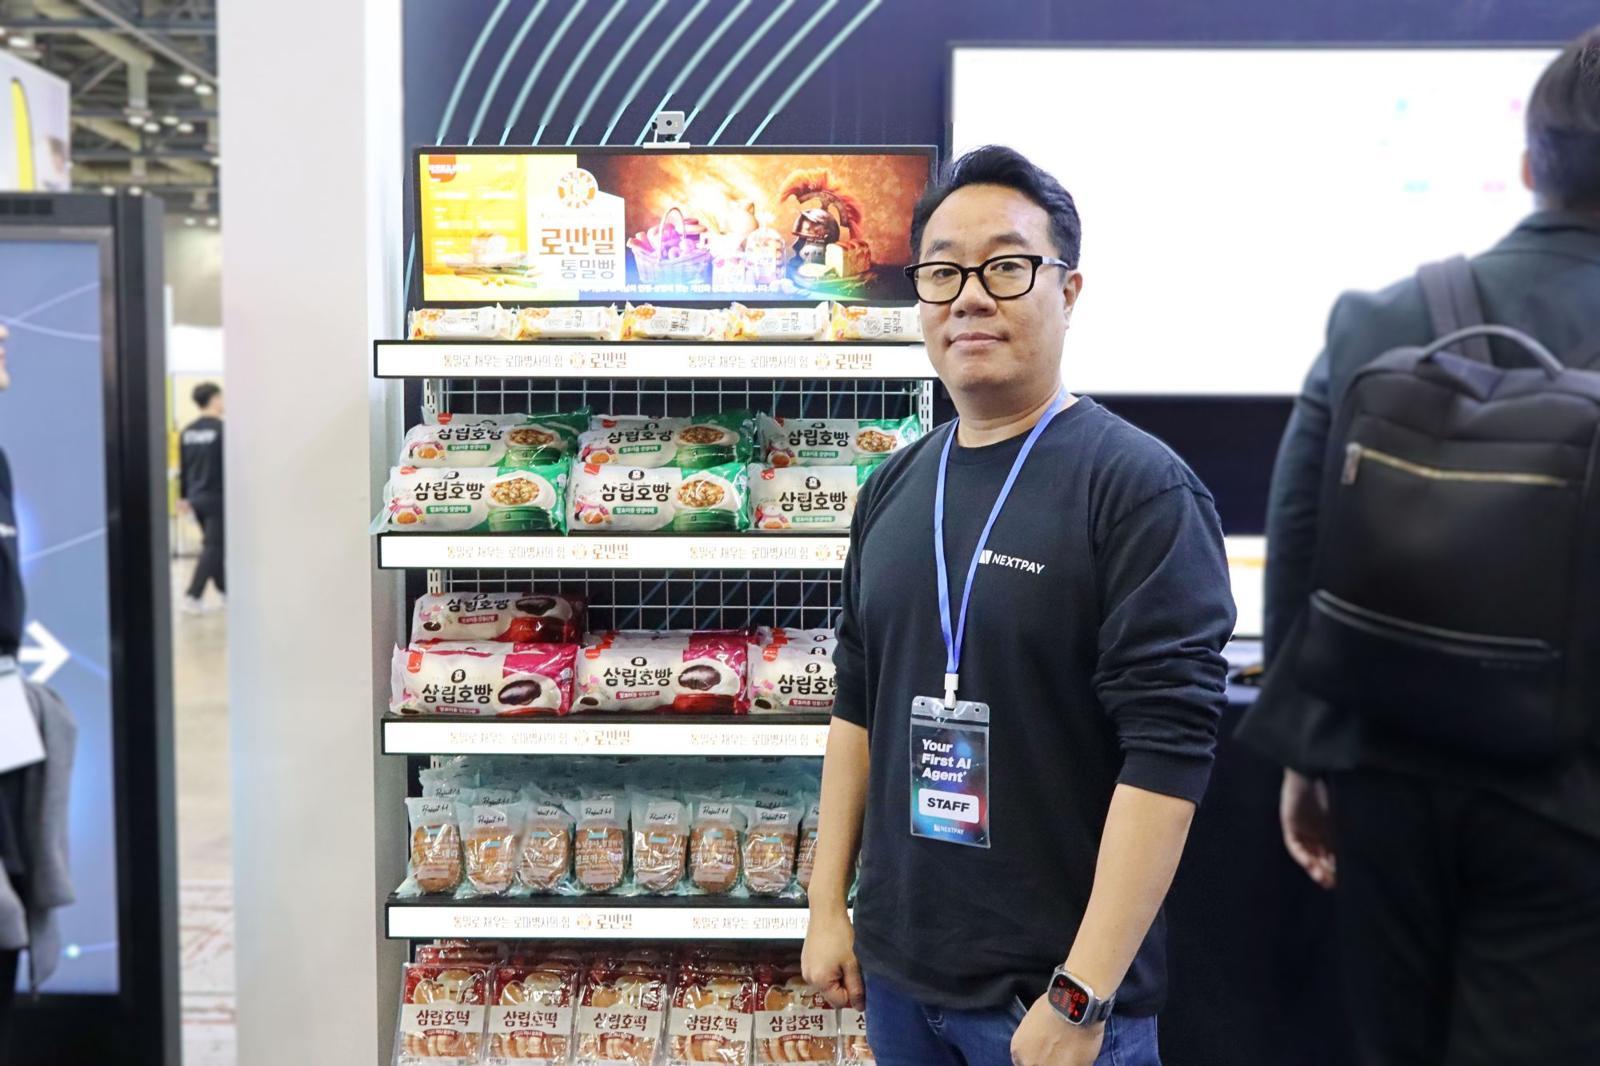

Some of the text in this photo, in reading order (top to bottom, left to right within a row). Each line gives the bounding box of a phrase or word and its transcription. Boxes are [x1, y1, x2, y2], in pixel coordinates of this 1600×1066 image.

[539, 227, 616, 255] 로만밀
[560, 259, 616, 279] 통밀빵
[591, 352, 627, 369] 로만밀
[835, 353, 872, 369] 로만밀
[437, 427, 504, 441] 삼립호빵
[607, 430, 674, 443] 삼립호빵
[788, 430, 850, 447] 삼립호빵
[413, 481, 485, 501] 삼립호빵
[601, 483, 672, 502] 삼립호빵
[779, 491, 848, 512] 삼립호빵
[592, 543, 628, 560] 로만밀
[992, 553, 1045, 574] NEXTPAY
[447, 597, 511, 613] 삼립호빵
[603, 667, 673, 687] 삼립호빵
[422, 683, 493, 704] 삼립호빵
[594, 729, 630, 745] 로만밀
[921, 738, 953, 753] Your
[921, 753, 971, 770] First AI
[927, 797, 970, 812] STAFF
[597, 914, 632, 930] 로만밀
[416, 1009, 471, 1026] 삼립호떡
[502, 1011, 558, 1028] 삼립호떡
[593, 1012, 648, 1031] 삼립호떡
[686, 1015, 738, 1034] 삼립호떡
[769, 1014, 823, 1032] 삼립호떡
